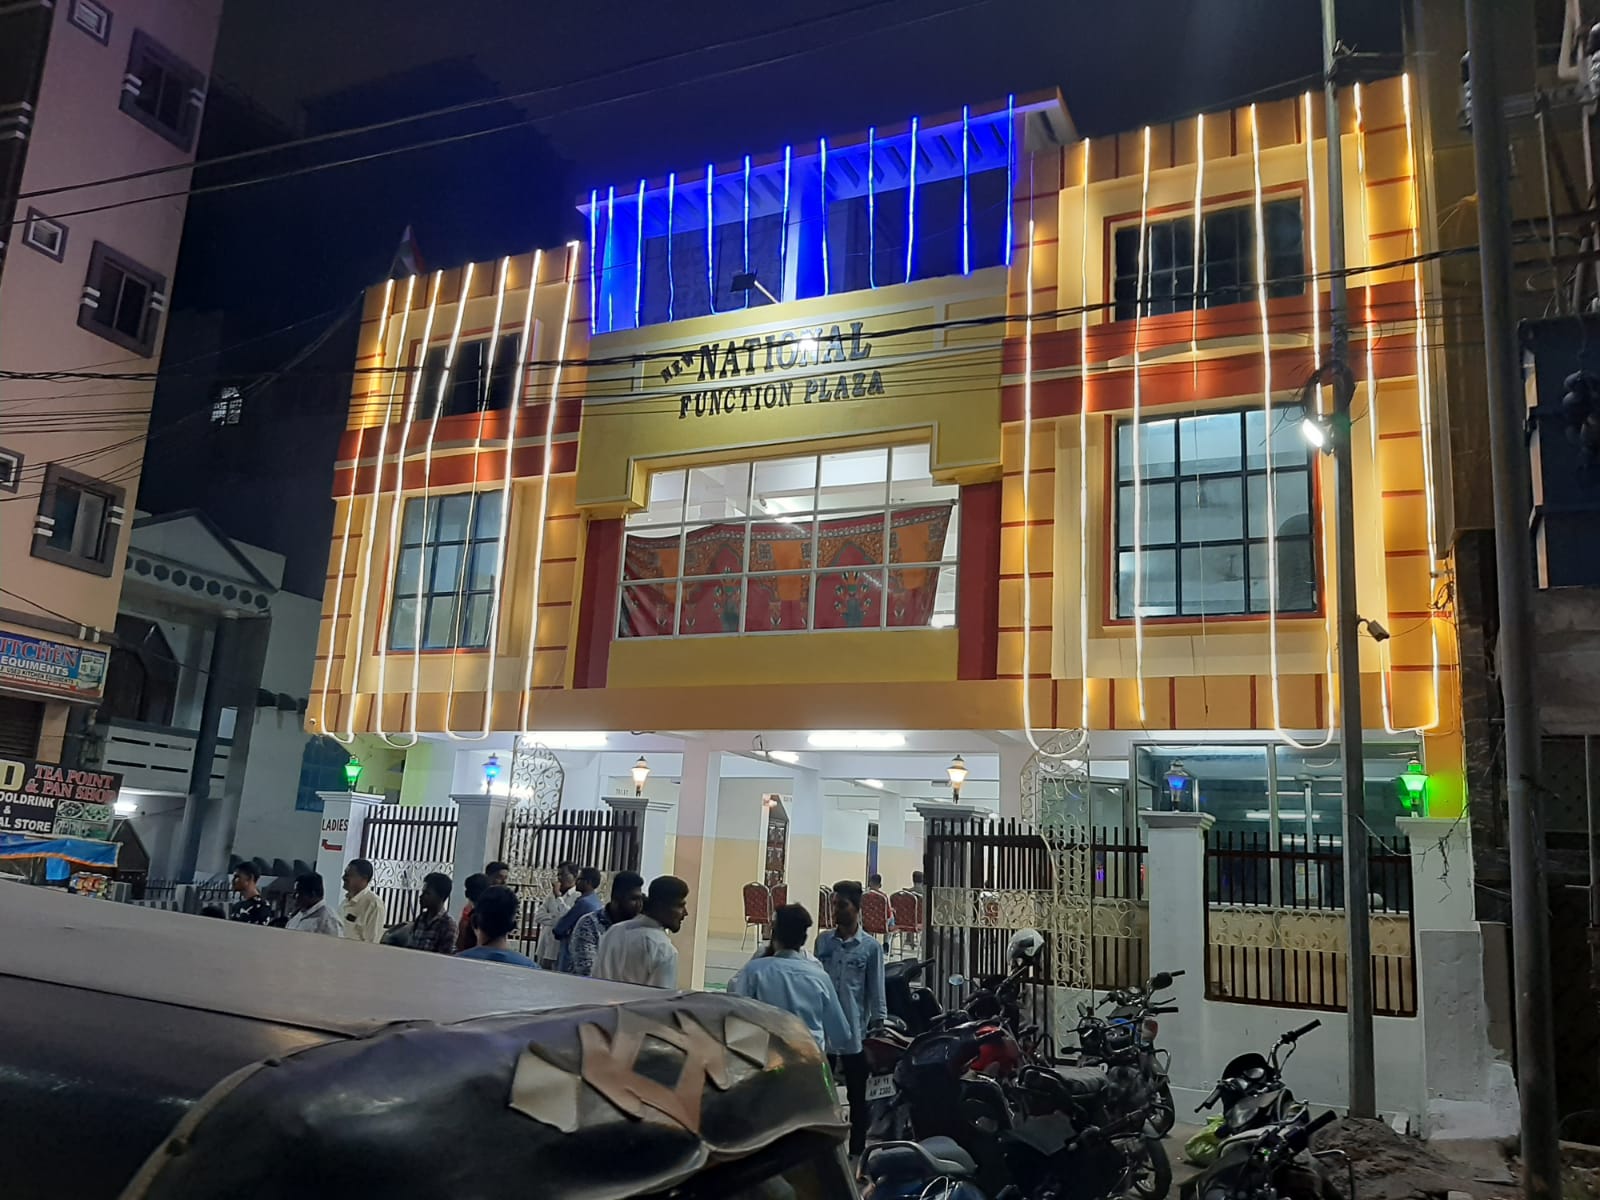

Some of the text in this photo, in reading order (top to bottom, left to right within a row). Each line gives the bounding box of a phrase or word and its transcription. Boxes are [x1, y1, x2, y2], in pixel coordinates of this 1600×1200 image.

[660, 321, 872, 383] NEW NATIONAL
[679, 370, 885, 419] FUNCTION PLAZA
[0, 638, 77, 667] ITCHEN
[1, 655, 69, 676] EQUIMENTS
[34, 764, 114, 789] TEA POINT
[25, 778, 117, 804] & PAN SHOP
[14, 818, 52, 833] STORE
[322, 818, 349, 831] LADIES
